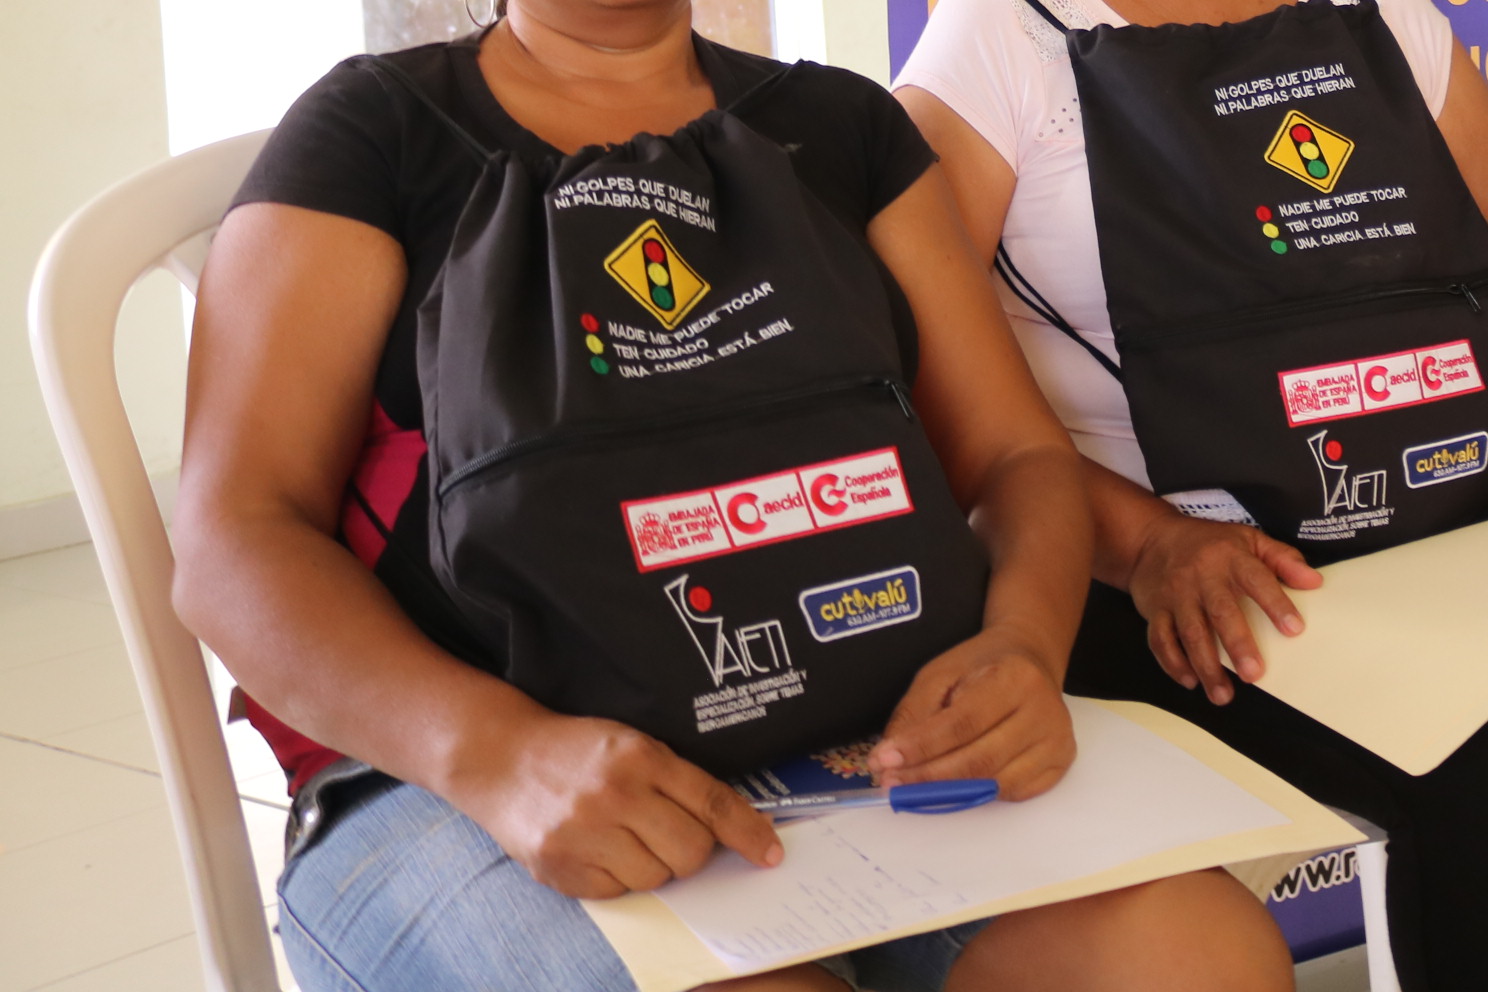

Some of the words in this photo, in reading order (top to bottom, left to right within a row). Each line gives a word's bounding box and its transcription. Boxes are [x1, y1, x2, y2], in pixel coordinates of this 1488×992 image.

[1214, 87, 1228, 101] NI
[1229, 78, 1273, 98] GOLPES
[1276, 72, 1299, 86] QUE
[1302, 63, 1345, 82] DUELAN
[1214, 104, 1227, 116] NI
[1229, 91, 1289, 113] PALABRAS
[1292, 85, 1315, 98] QUE
[1317, 77, 1355, 95] HIERAN
[558, 185, 574, 197] NI
[578, 177, 634, 194] GOLPES
[640, 179, 665, 197] QUE
[669, 186, 709, 213] DUELAN
[1279, 199, 1311, 217] NADIE
[1314, 197, 1332, 211] ME
[1335, 192, 1369, 208] PUEDE
[1370, 187, 1407, 201] TOCAR
[554, 198, 570, 209] NI
[575, 193, 650, 210] PALABRAS
[654, 198, 676, 216] QUE
[679, 208, 716, 232] HIERAN
[1286, 219, 1309, 233] TEN
[1311, 211, 1358, 229] CUIDADO
[1295, 236, 1319, 249] UNA
[1321, 231, 1363, 245] CARICIA
[1365, 223, 1391, 239] ESTÁ
[1394, 222, 1416, 235] BIEN
[608, 321, 645, 343] NADIE
[650, 333, 672, 345] ME
[674, 310, 720, 343] PUEDE
[722, 282, 774, 315] TOCAR
[613, 344, 640, 359] TEN
[644, 338, 708, 360] CUIDADO
[618, 365, 650, 378] UNA
[655, 354, 715, 373] CARICIA
[718, 332, 757, 358] ESTÁ
[760, 318, 794, 341] BIEN
[1390, 368, 1416, 386] aecid
[764, 492, 803, 515] aecid
